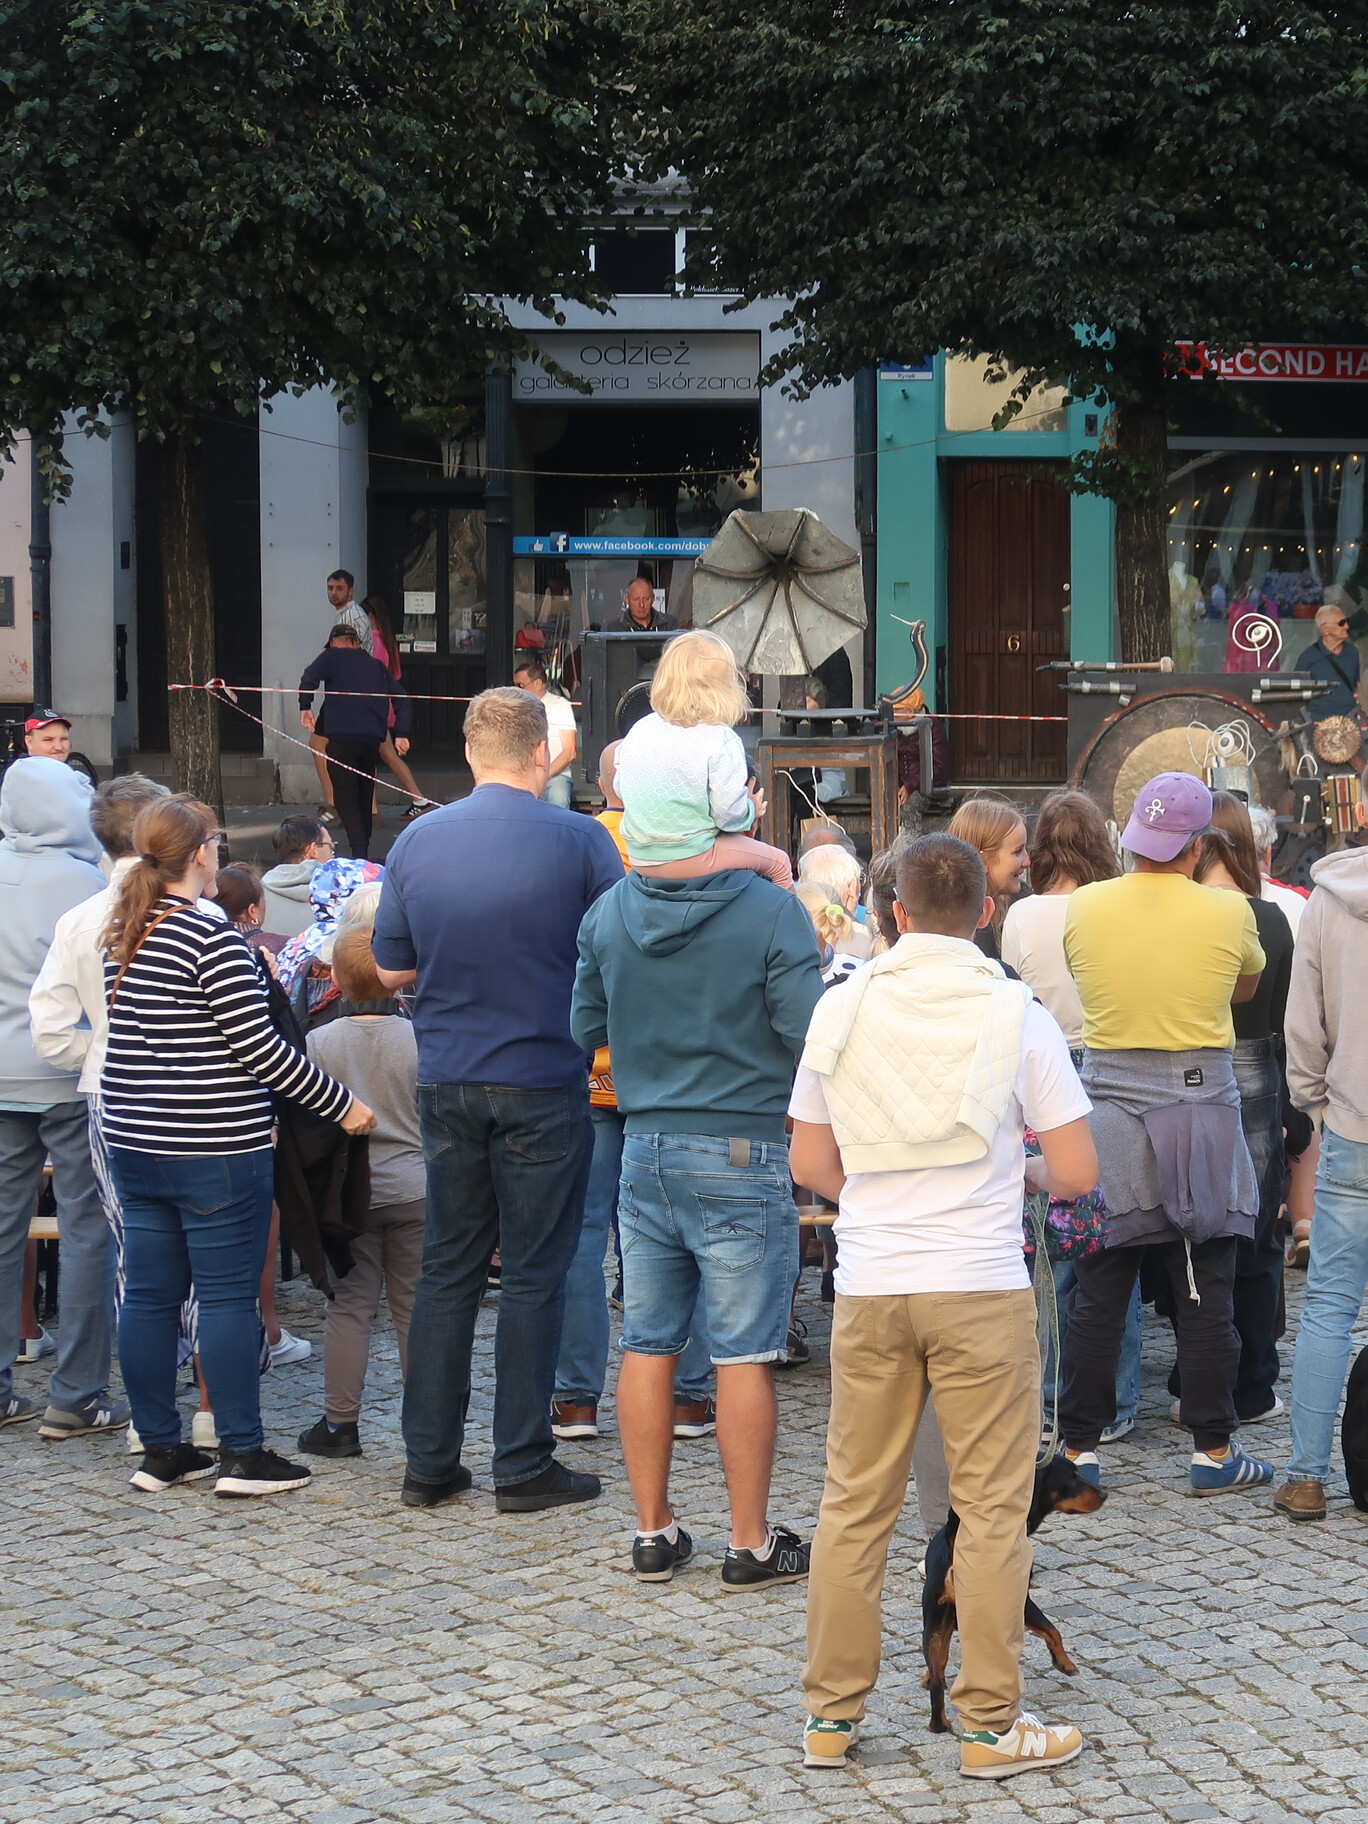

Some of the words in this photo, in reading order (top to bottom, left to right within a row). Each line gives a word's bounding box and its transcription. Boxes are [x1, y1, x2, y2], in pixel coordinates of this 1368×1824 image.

[580, 338, 690, 365] odzież
[520, 372, 629, 394] galateria
[647, 372, 751, 390] skórzana
[574, 541, 709, 550] www.facebook.com/dob
[1008, 634, 1020, 651] 6
[777, 1550, 798, 1572] N
[1021, 1731, 1047, 1757] N
